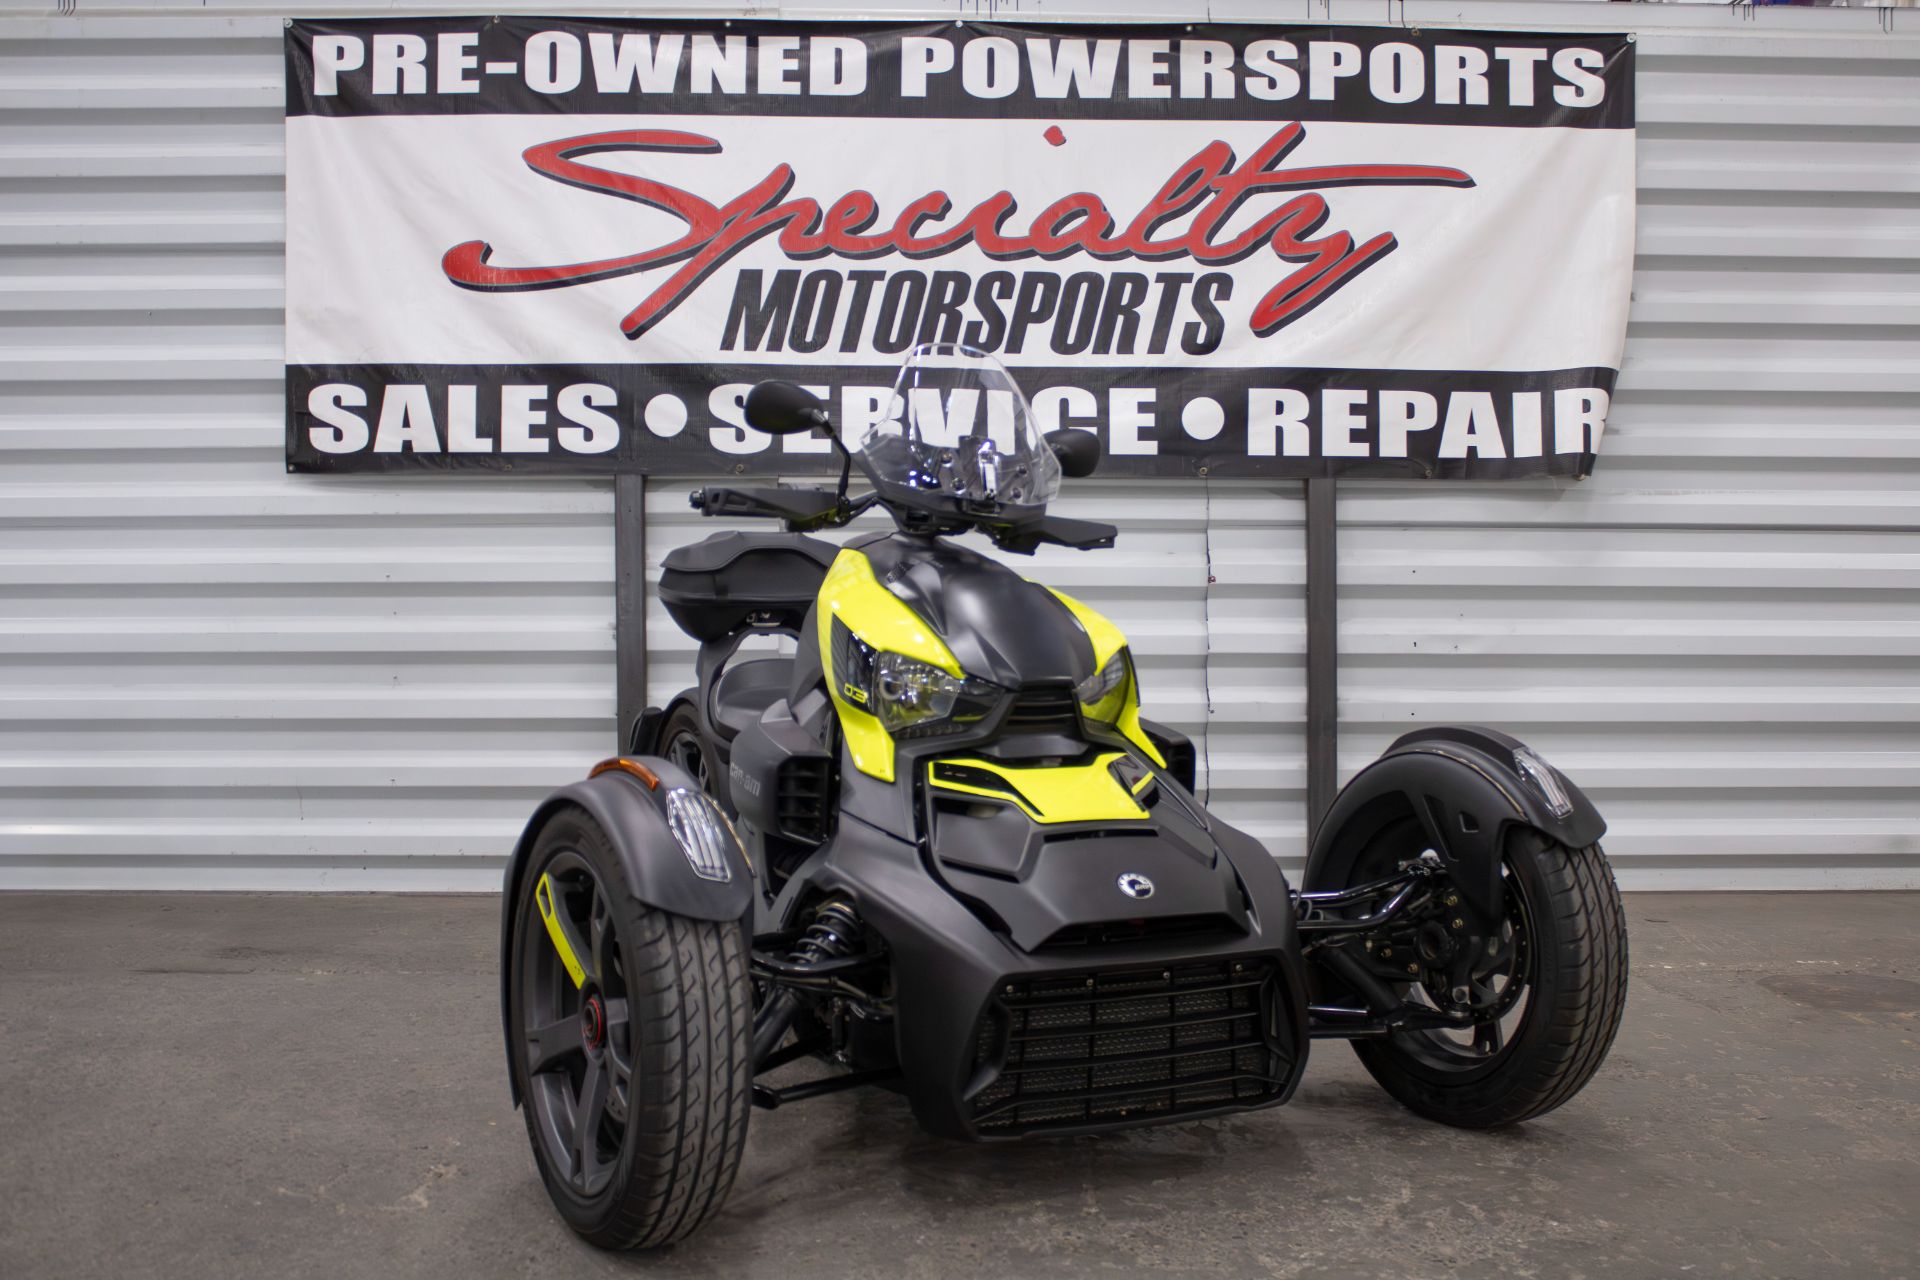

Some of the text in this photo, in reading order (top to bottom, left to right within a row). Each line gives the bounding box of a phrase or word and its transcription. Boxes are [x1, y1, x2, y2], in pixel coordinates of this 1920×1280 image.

[312, 31, 1606, 108] PRE-OWNED POWERSPORTS
[441, 120, 1477, 340] Specialty
[719, 268, 1234, 355] MOTORSPORTS
[307, 382, 620, 455] SALES
[1247, 387, 1609, 459] REPAIR
